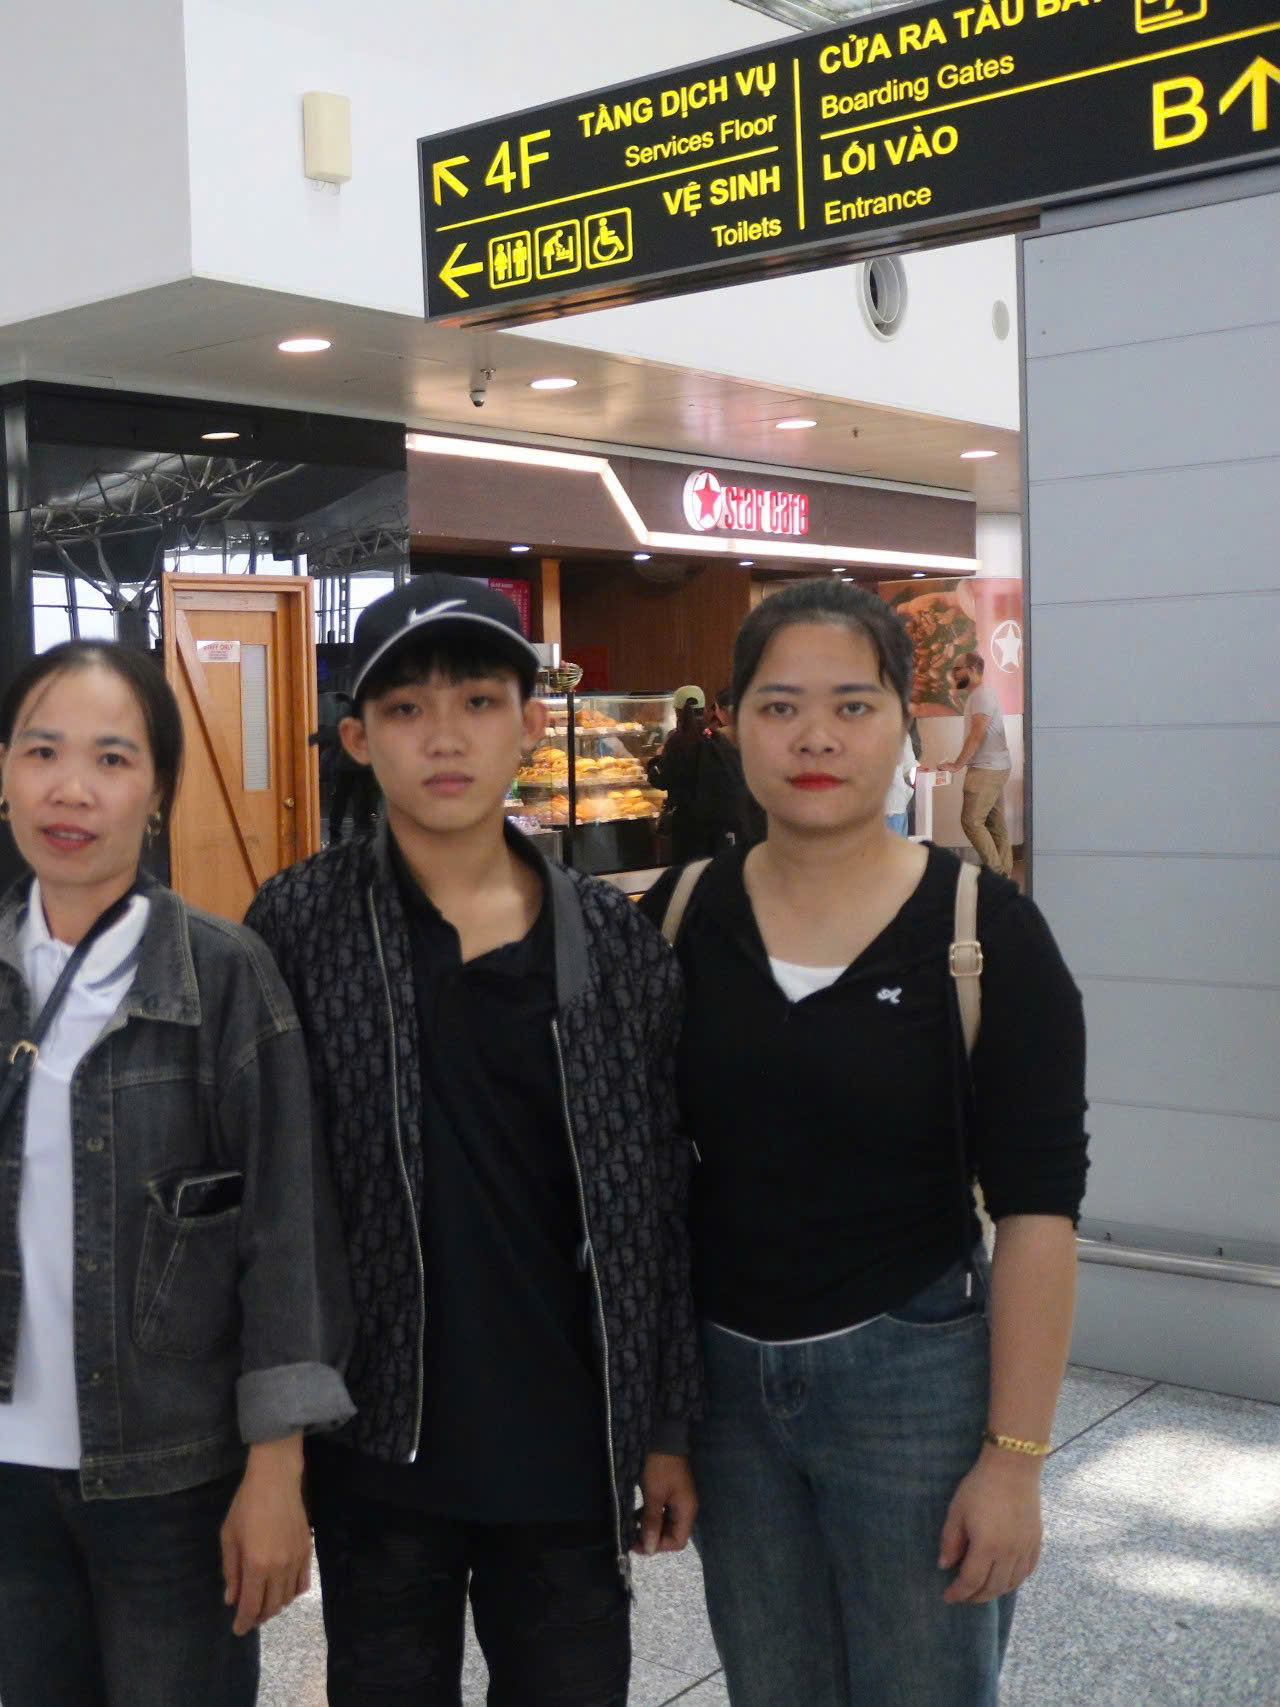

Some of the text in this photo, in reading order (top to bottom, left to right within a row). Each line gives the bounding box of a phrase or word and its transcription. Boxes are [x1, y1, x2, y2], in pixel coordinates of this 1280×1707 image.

[819, 32, 892, 74] CỬA
[898, 18, 948, 55] RA
[660, 76, 728, 119] DỊCH
[736, 62, 777, 97] VỤ
[821, 55, 1015, 120] Boarding Gates
[1152, 76, 1208, 150] B
[484, 128, 552, 195] 4F
[625, 115, 777, 168] Services Floor
[884, 124, 959, 166] VÀO
[662, 165, 781, 217] VỆ SINH
[824, 187, 933, 225] Entrance
[711, 216, 782, 248] Toilets
